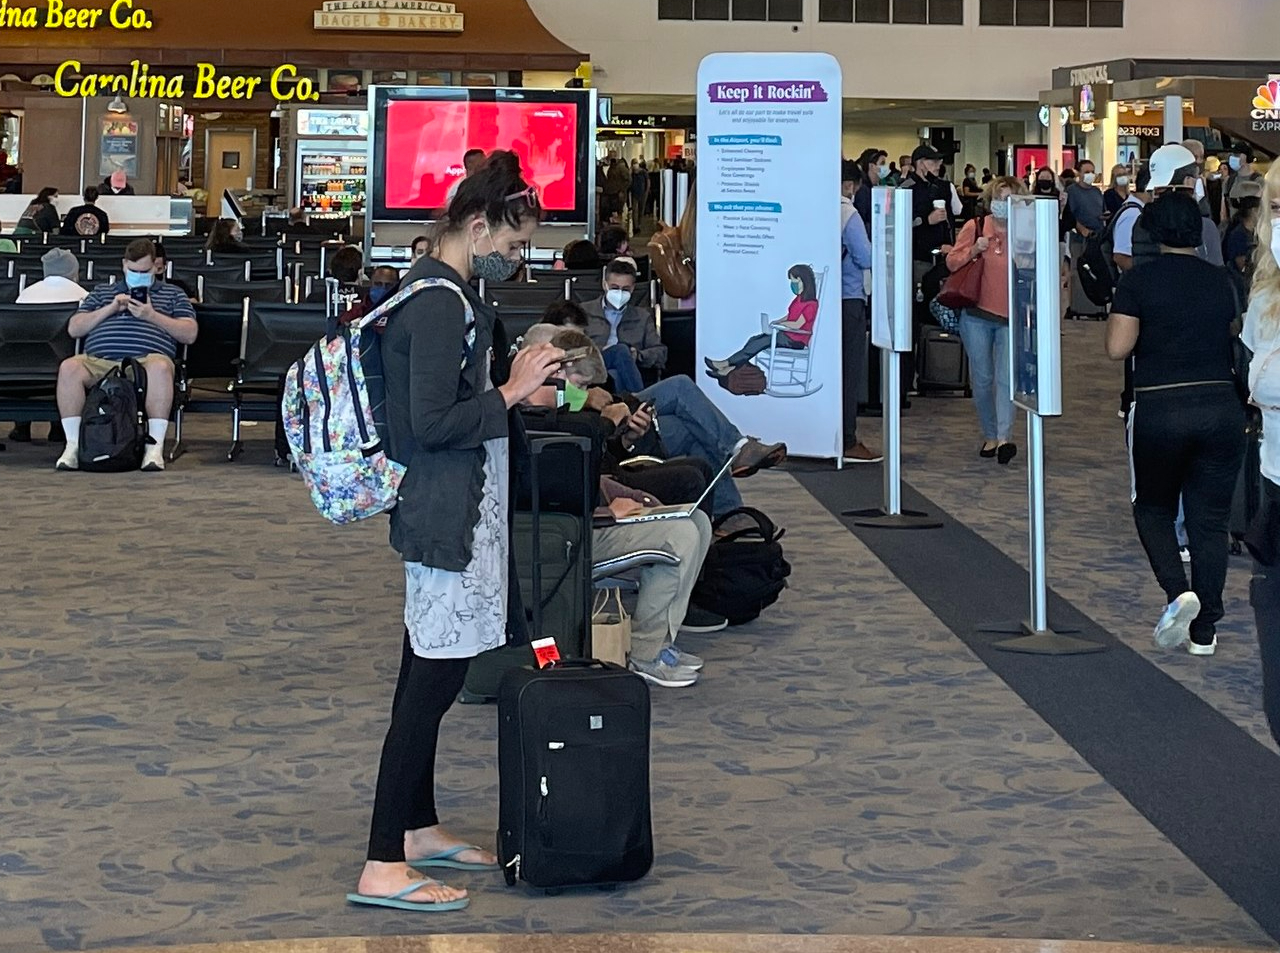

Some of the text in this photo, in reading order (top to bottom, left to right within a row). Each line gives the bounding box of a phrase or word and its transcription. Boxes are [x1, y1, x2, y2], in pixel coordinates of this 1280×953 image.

[326, 0, 453, 14] THE GREAT AMERICAN
[320, 14, 459, 29] BAGEL BAKERY
[54, 59, 320, 101] Carolina Beer Co.
[717, 84, 749, 103] Keep
[753, 84, 763, 99] it
